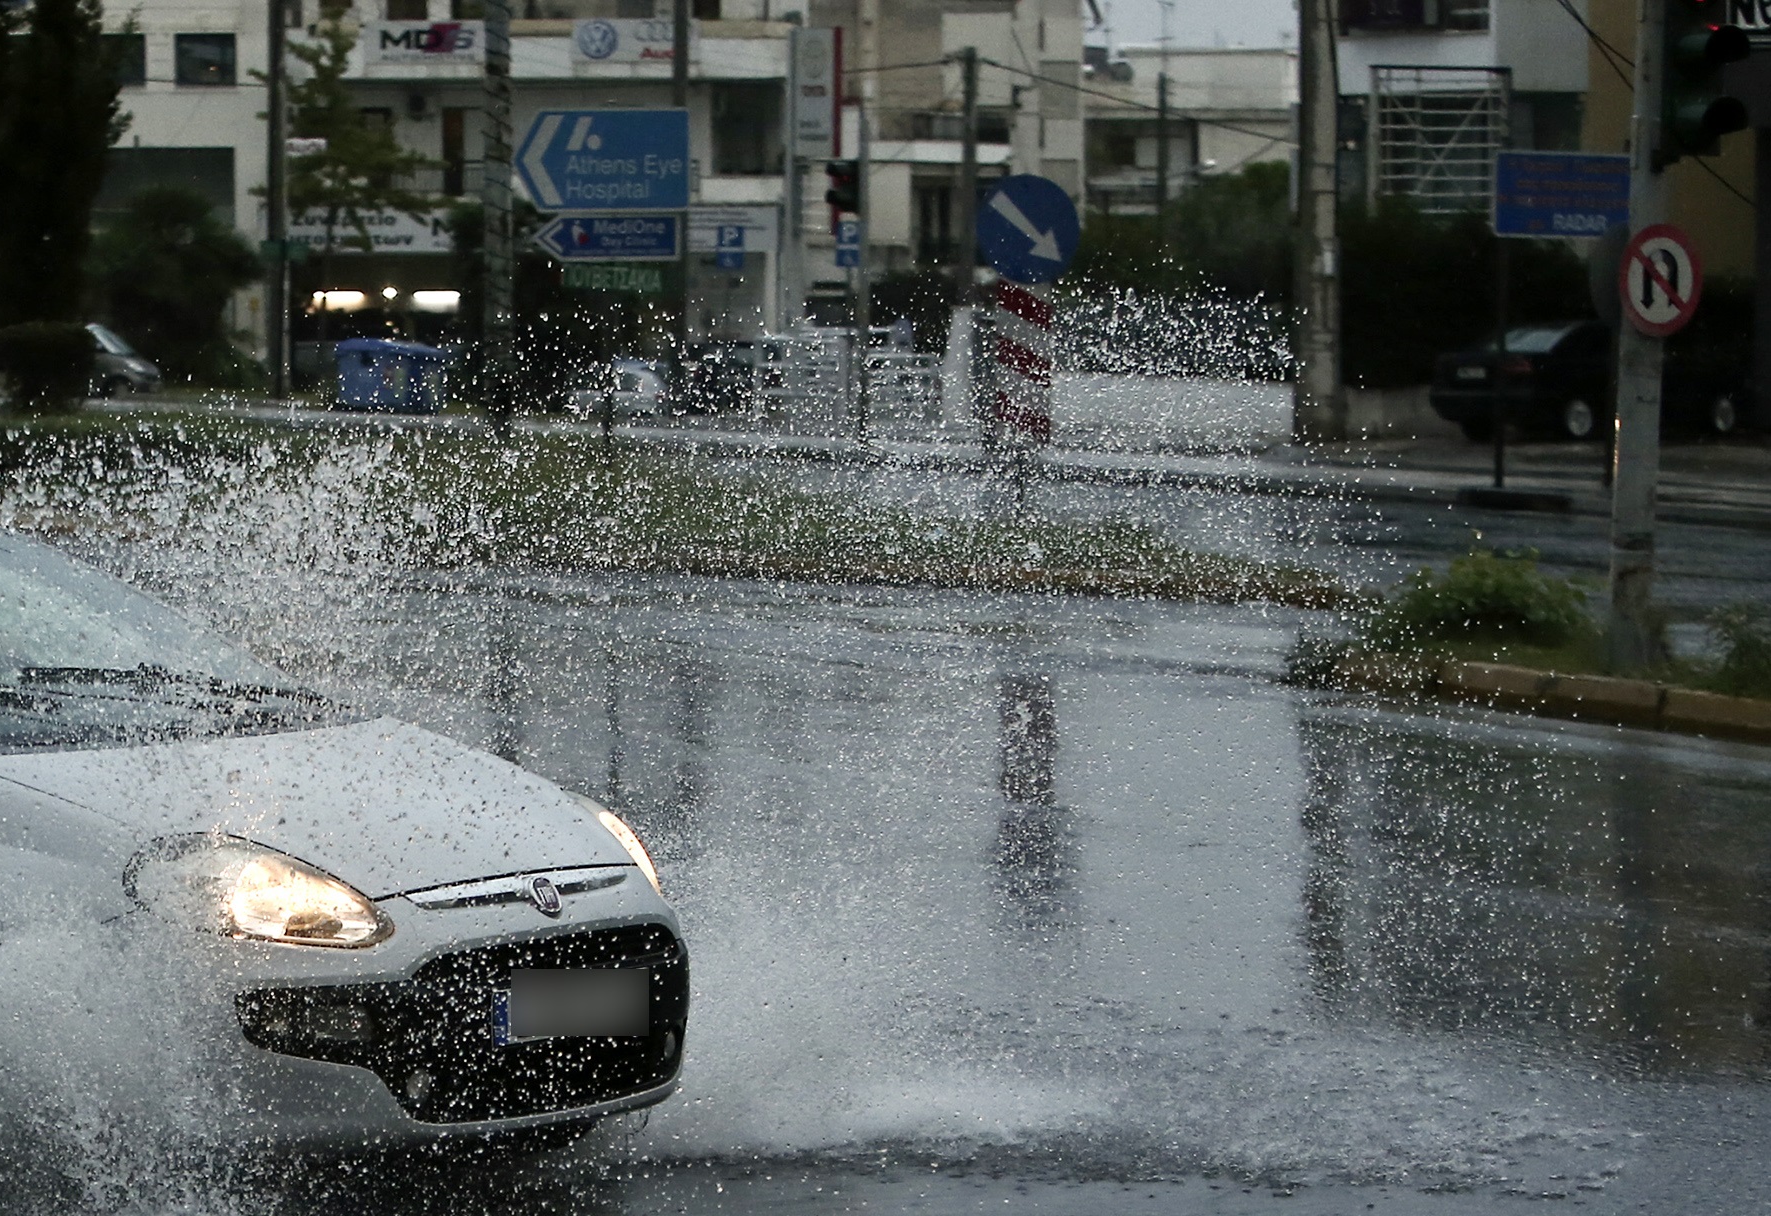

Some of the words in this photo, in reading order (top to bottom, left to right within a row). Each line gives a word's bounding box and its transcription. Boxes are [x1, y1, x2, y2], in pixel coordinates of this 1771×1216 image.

[565, 154, 638, 175] Athens
[644, 153, 683, 178] Eye
[565, 178, 650, 204] Hospital
[592, 218, 666, 234] MediOne
[1552, 213, 1608, 232] RADAR
